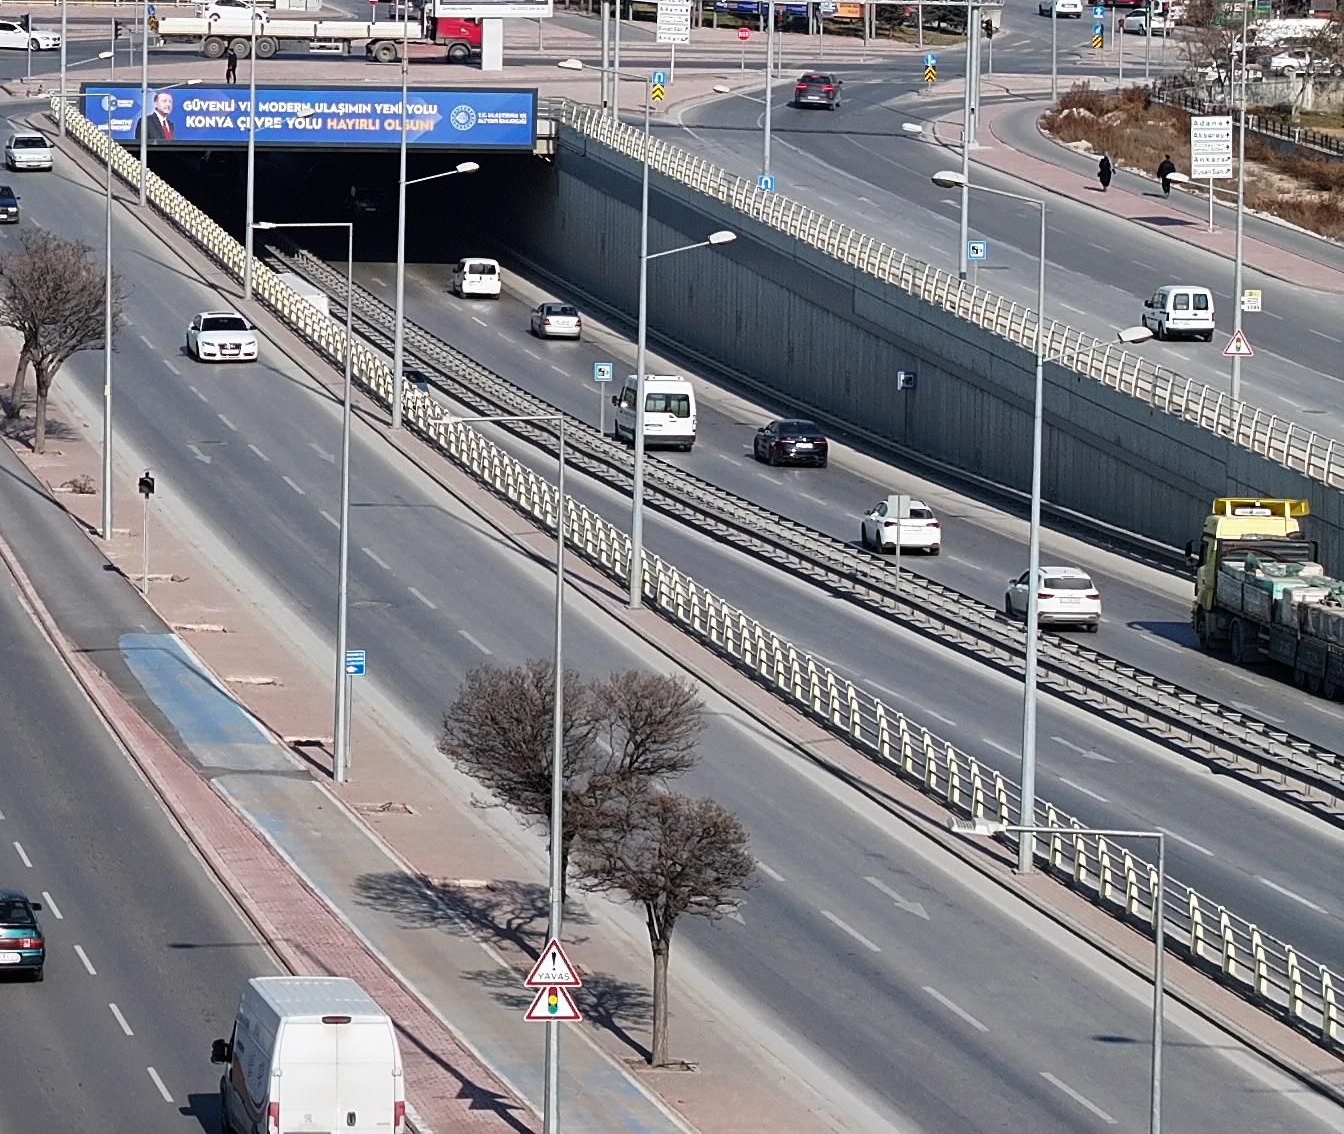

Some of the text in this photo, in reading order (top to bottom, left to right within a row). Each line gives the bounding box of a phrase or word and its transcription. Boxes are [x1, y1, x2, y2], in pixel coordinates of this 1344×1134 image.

[183, 98, 234, 112] GÜVENLİ
[259, 100, 311, 113] MODERN
[314, 102, 371, 116] ULAŞIMIN
[374, 101, 403, 114] YENİ
[405, 104, 438, 115] YOLU
[185, 116, 233, 128] KONYA
[285, 116, 322, 130] YOLU
[327, 118, 380, 131] HAYIRLI
